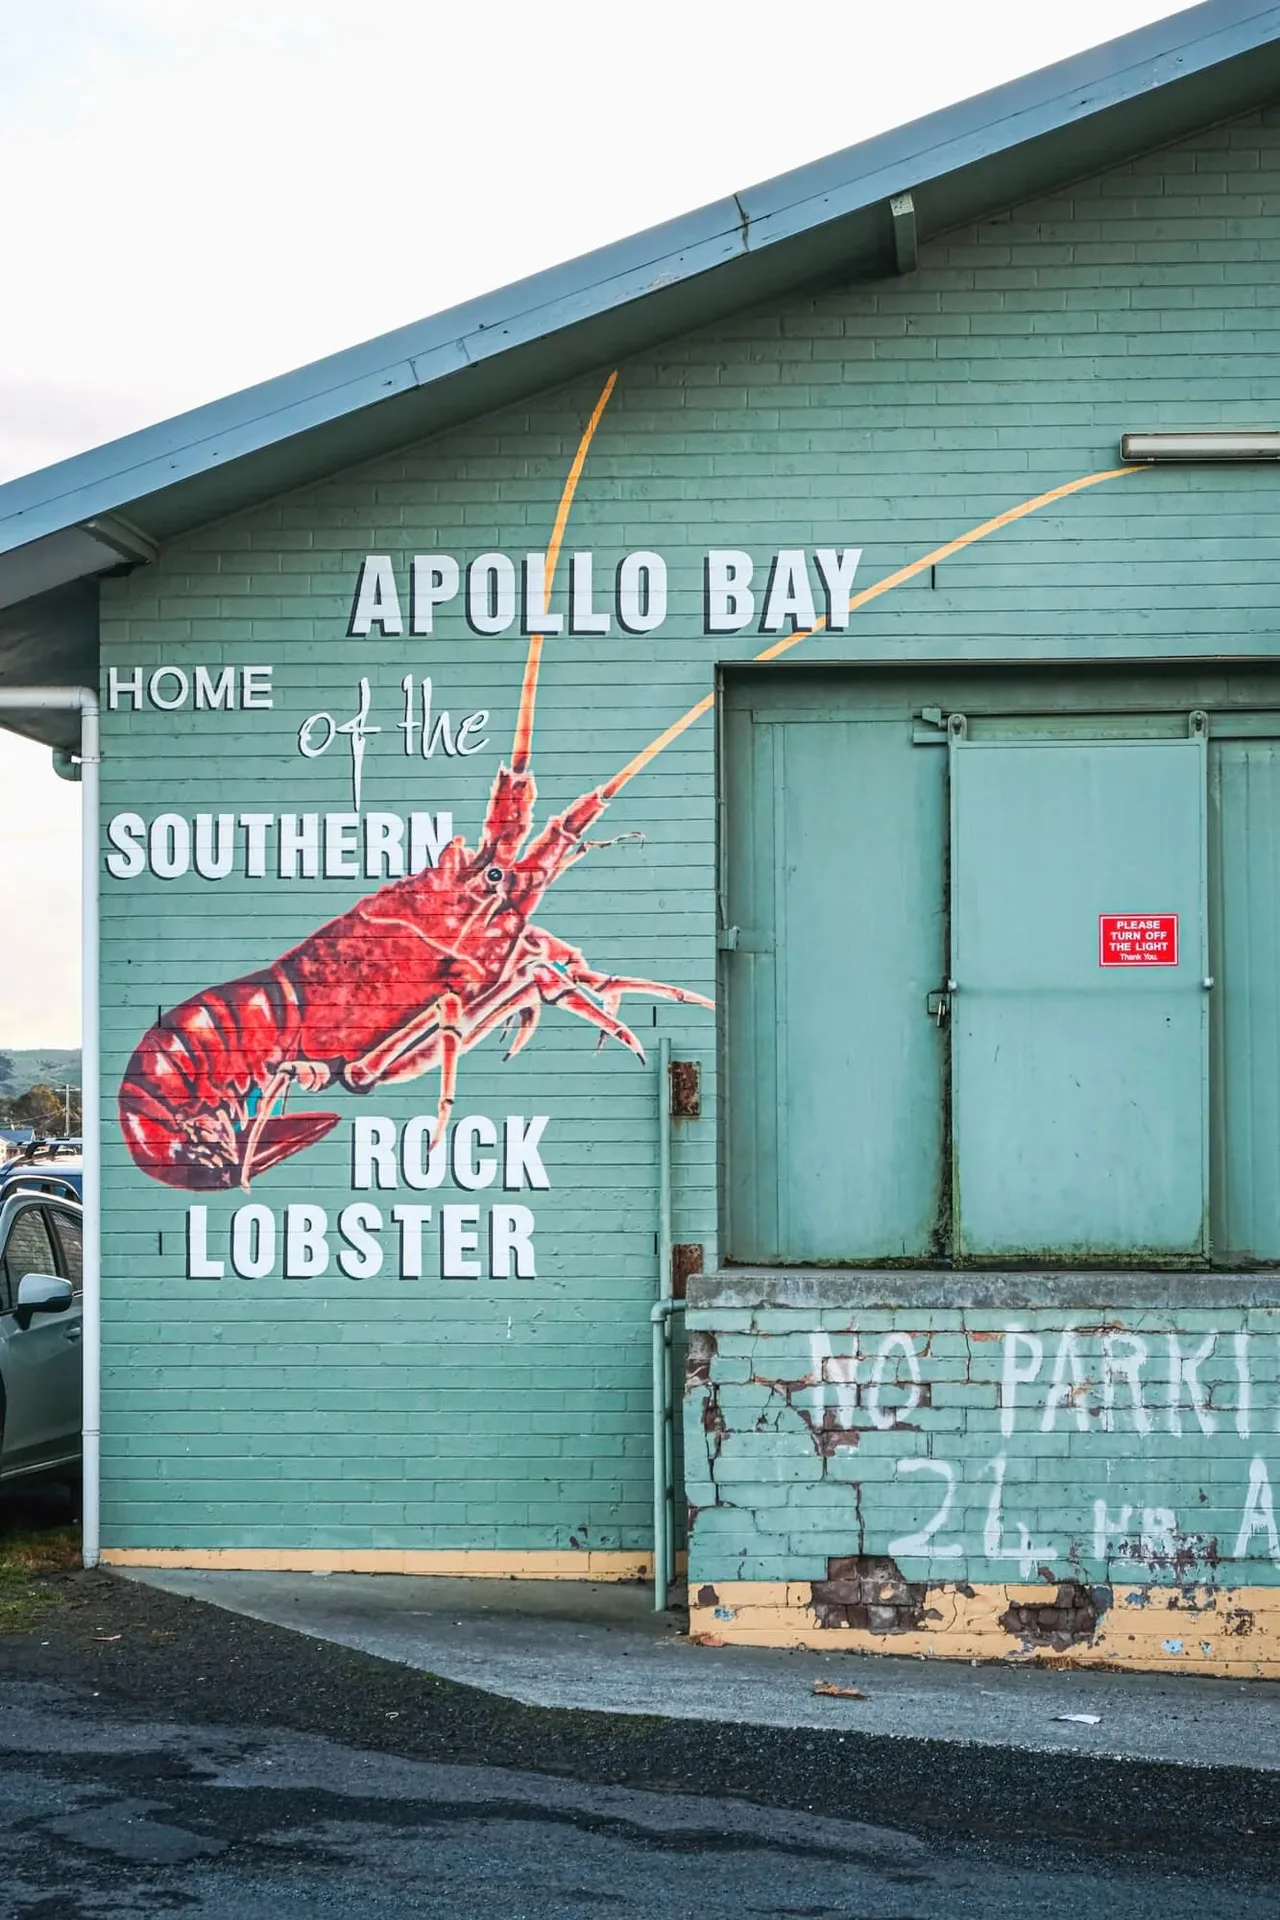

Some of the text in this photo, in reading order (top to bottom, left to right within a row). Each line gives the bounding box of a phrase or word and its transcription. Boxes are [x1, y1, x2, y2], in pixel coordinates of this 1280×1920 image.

[346, 548, 863, 637] APOLLO BAY
[107, 665, 273, 711] HOME
[298, 673, 490, 812] of the
[106, 811, 453, 881] SOUTHERN
[1109, 942, 1169, 952] THE LIGHT
[1110, 931, 1167, 941] TURN OFF
[1116, 920, 1161, 930] PLEASE
[1120, 953, 1142, 961] Thank
[351, 1114, 551, 1192] ROCK
[186, 1202, 538, 1281] LOBSTER
[807, 1322, 1280, 1440] NO PARKI
[887, 1452, 1058, 1579] 24
